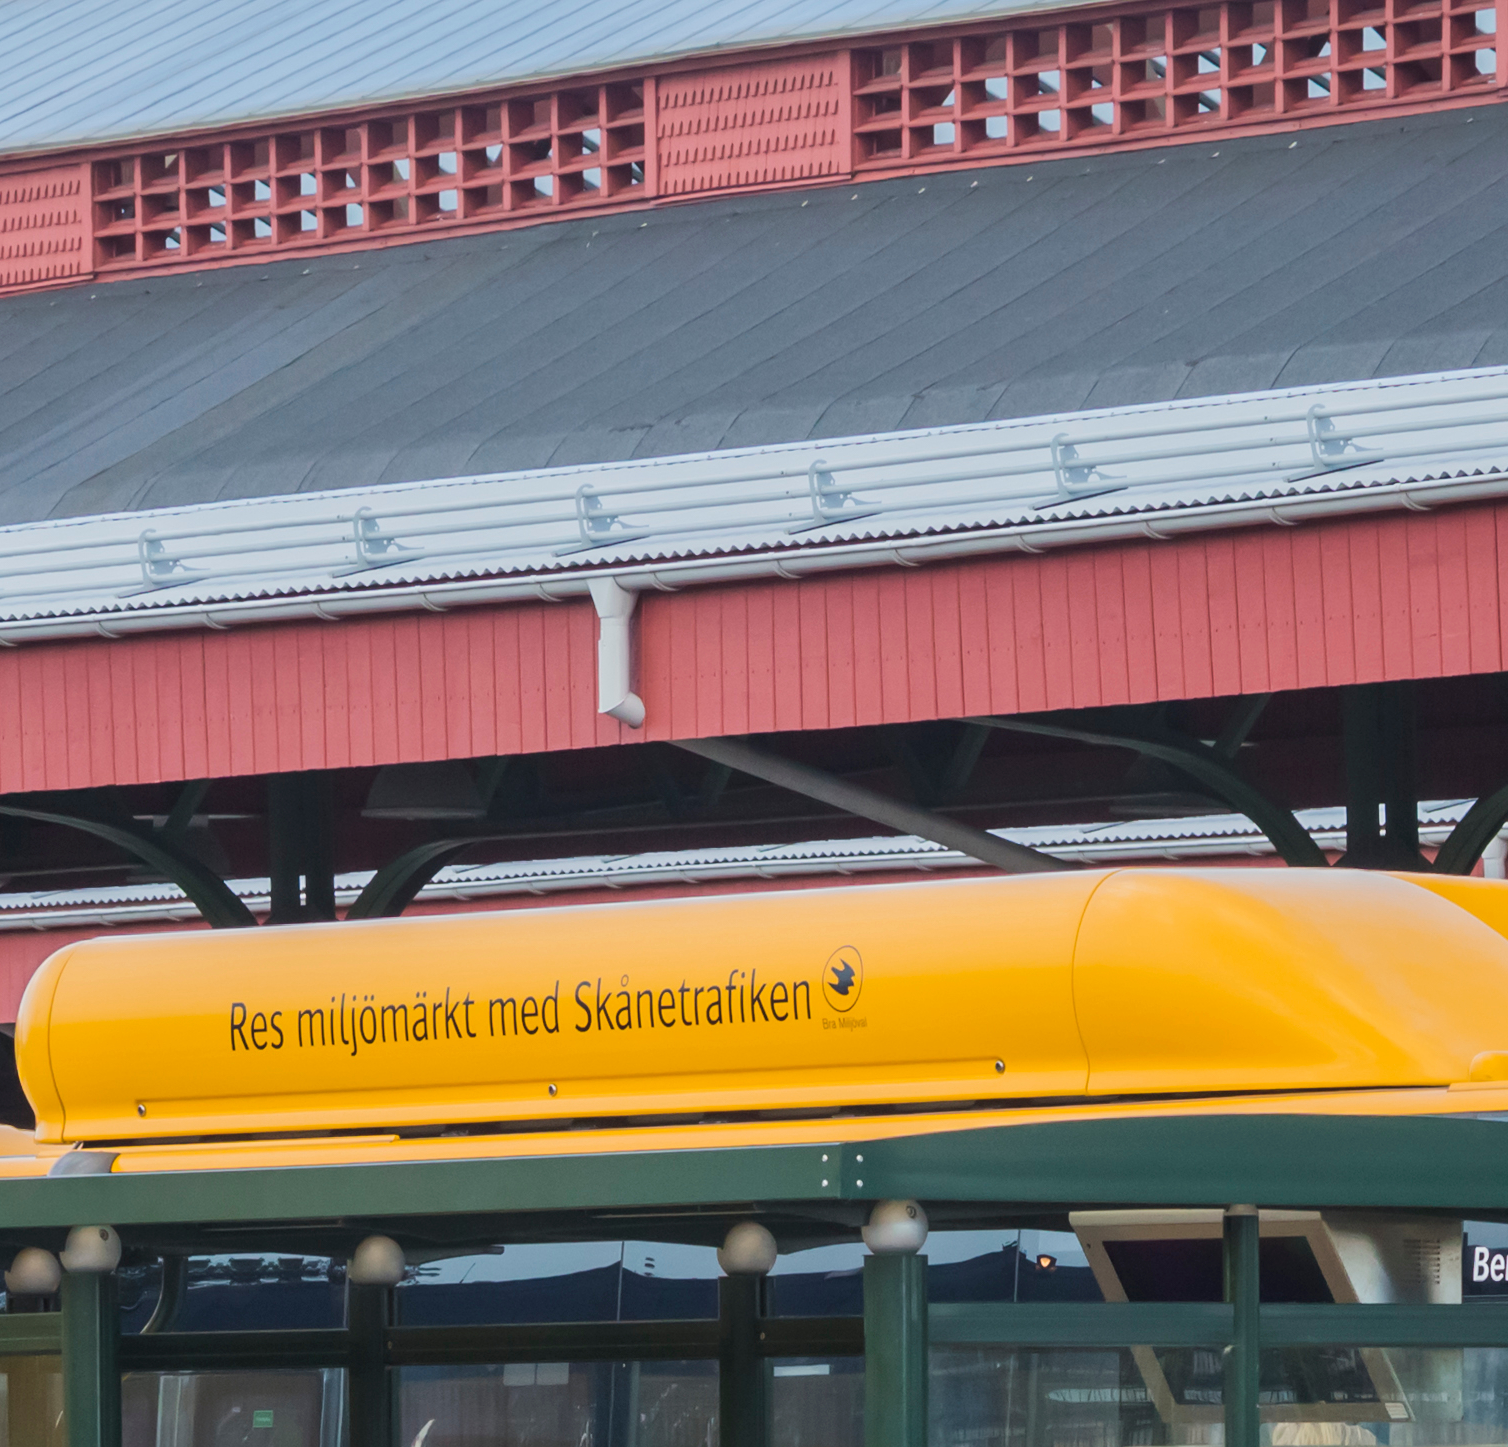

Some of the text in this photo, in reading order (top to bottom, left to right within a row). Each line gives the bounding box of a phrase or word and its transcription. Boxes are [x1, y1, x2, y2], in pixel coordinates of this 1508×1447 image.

[230, 967, 811, 1057] Res miljömärkt med Skånetrafiken
[821, 1018, 837, 1030] Bra
